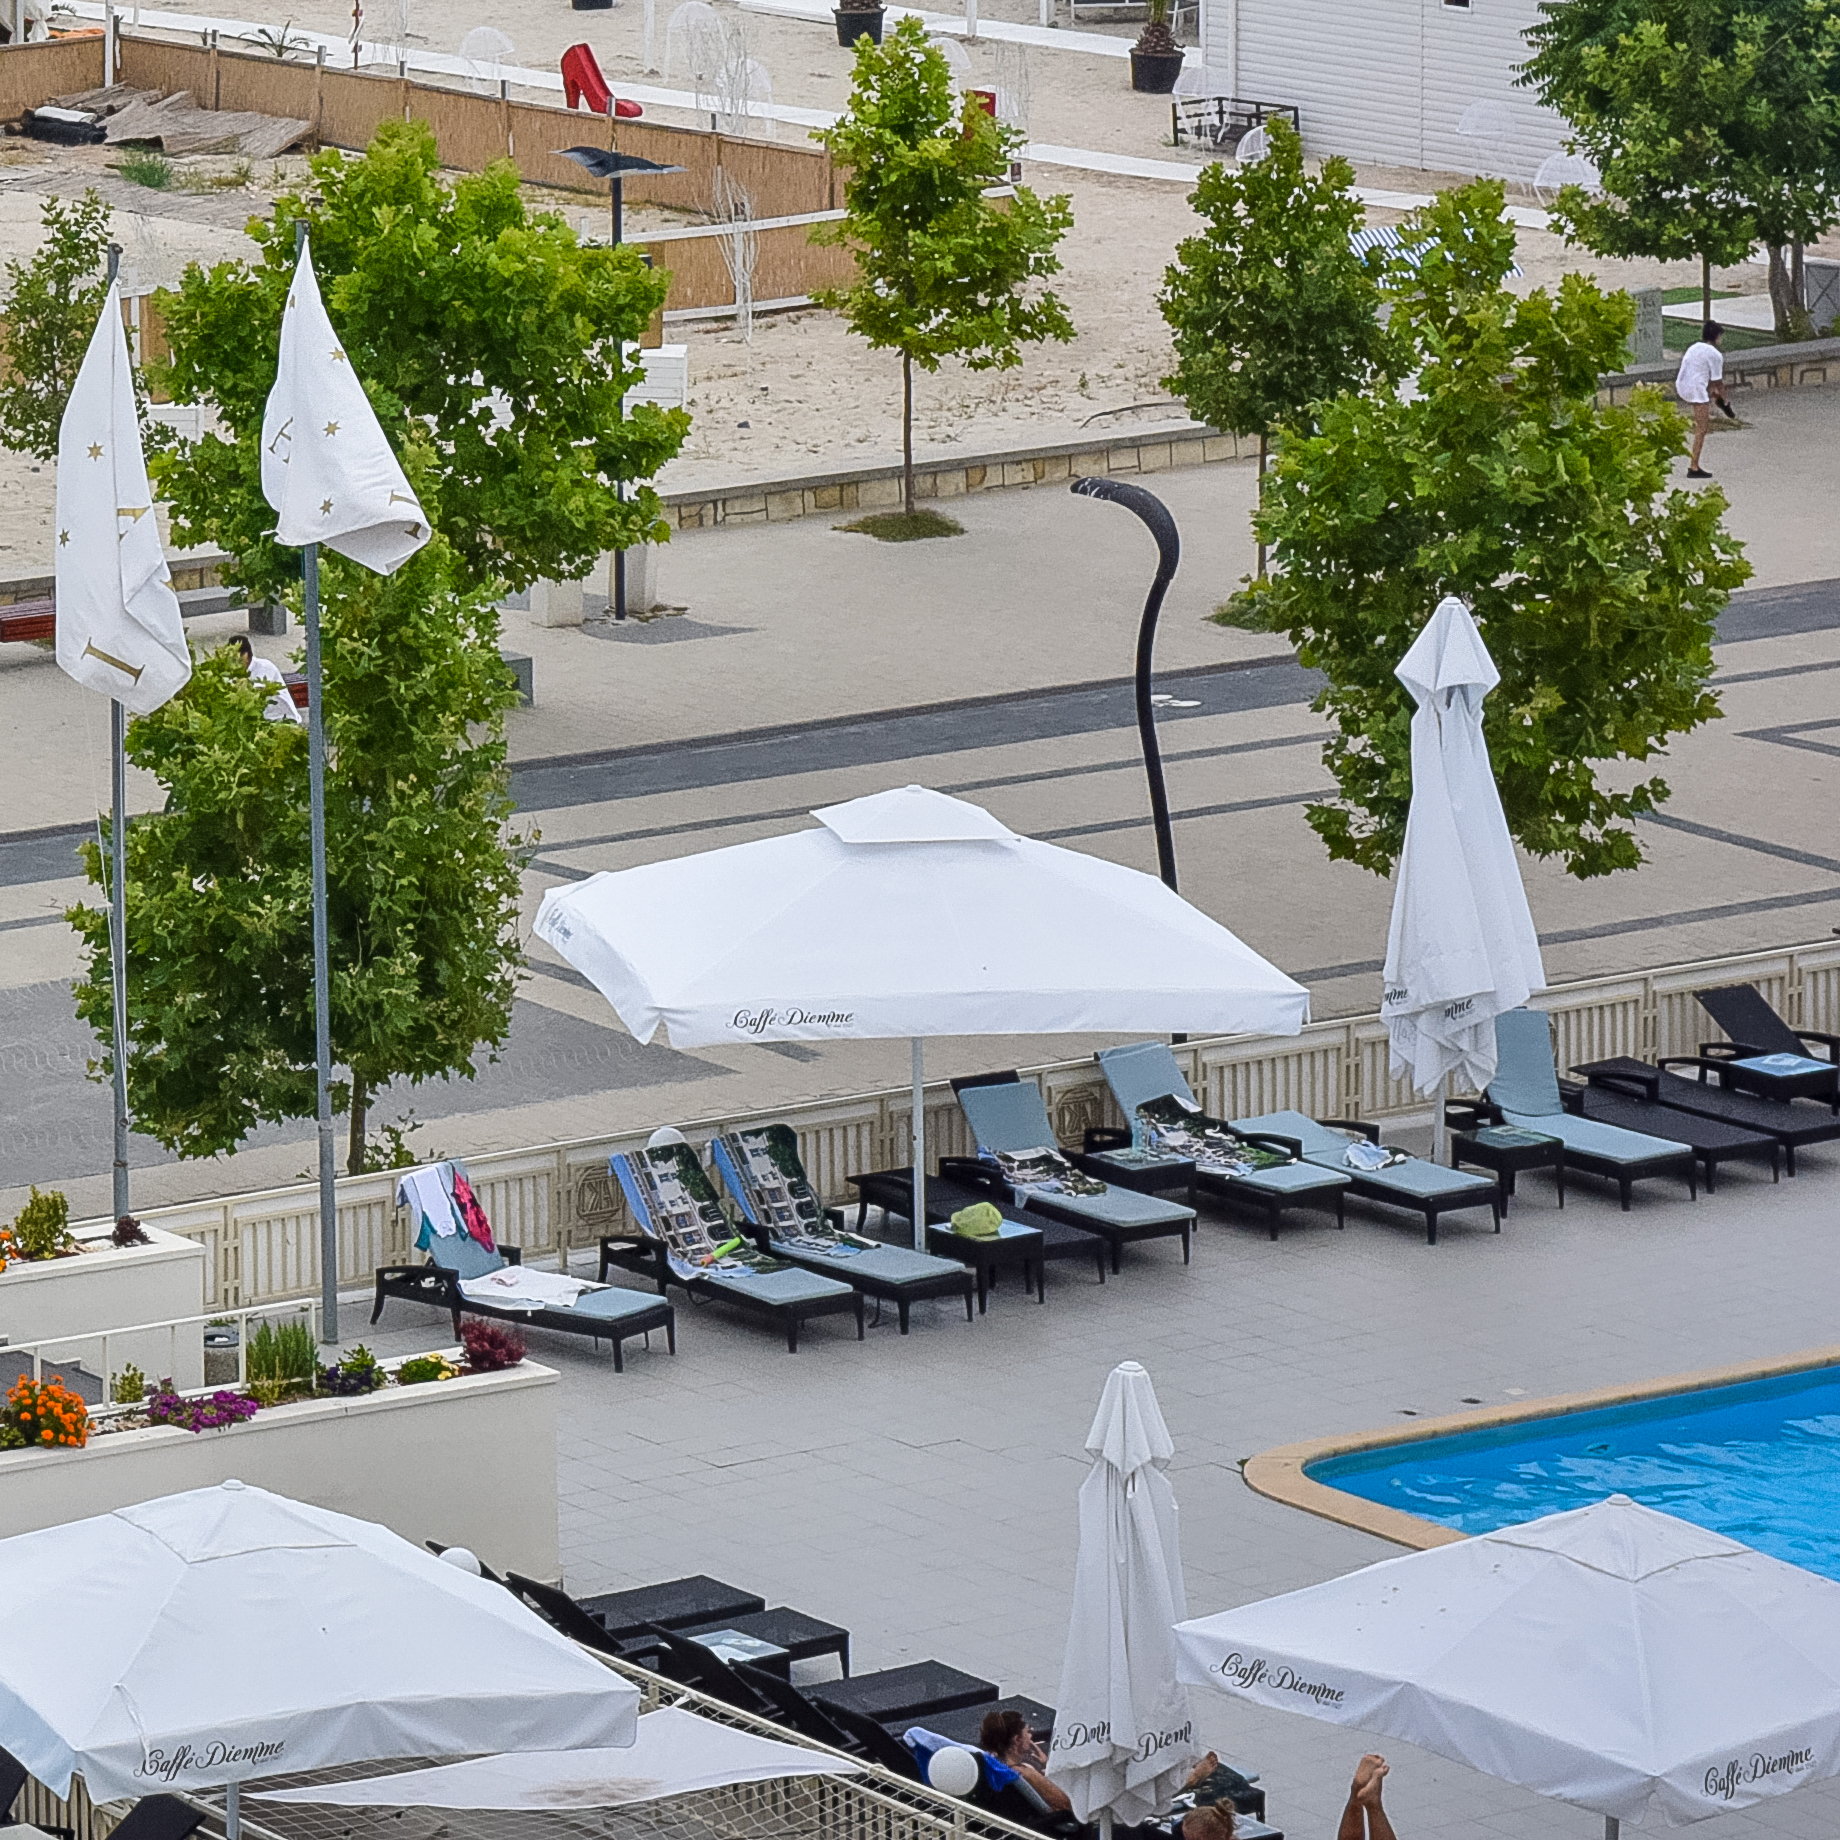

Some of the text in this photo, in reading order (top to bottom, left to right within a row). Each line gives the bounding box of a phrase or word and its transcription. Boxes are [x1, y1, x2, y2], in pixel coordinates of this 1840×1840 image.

[777, 1007, 854, 1029] Diemme
[1268, 1666, 1345, 1704] Diemme
[195, 1739, 286, 1770] Diemme
[1743, 1747, 1814, 1783] Diemme
